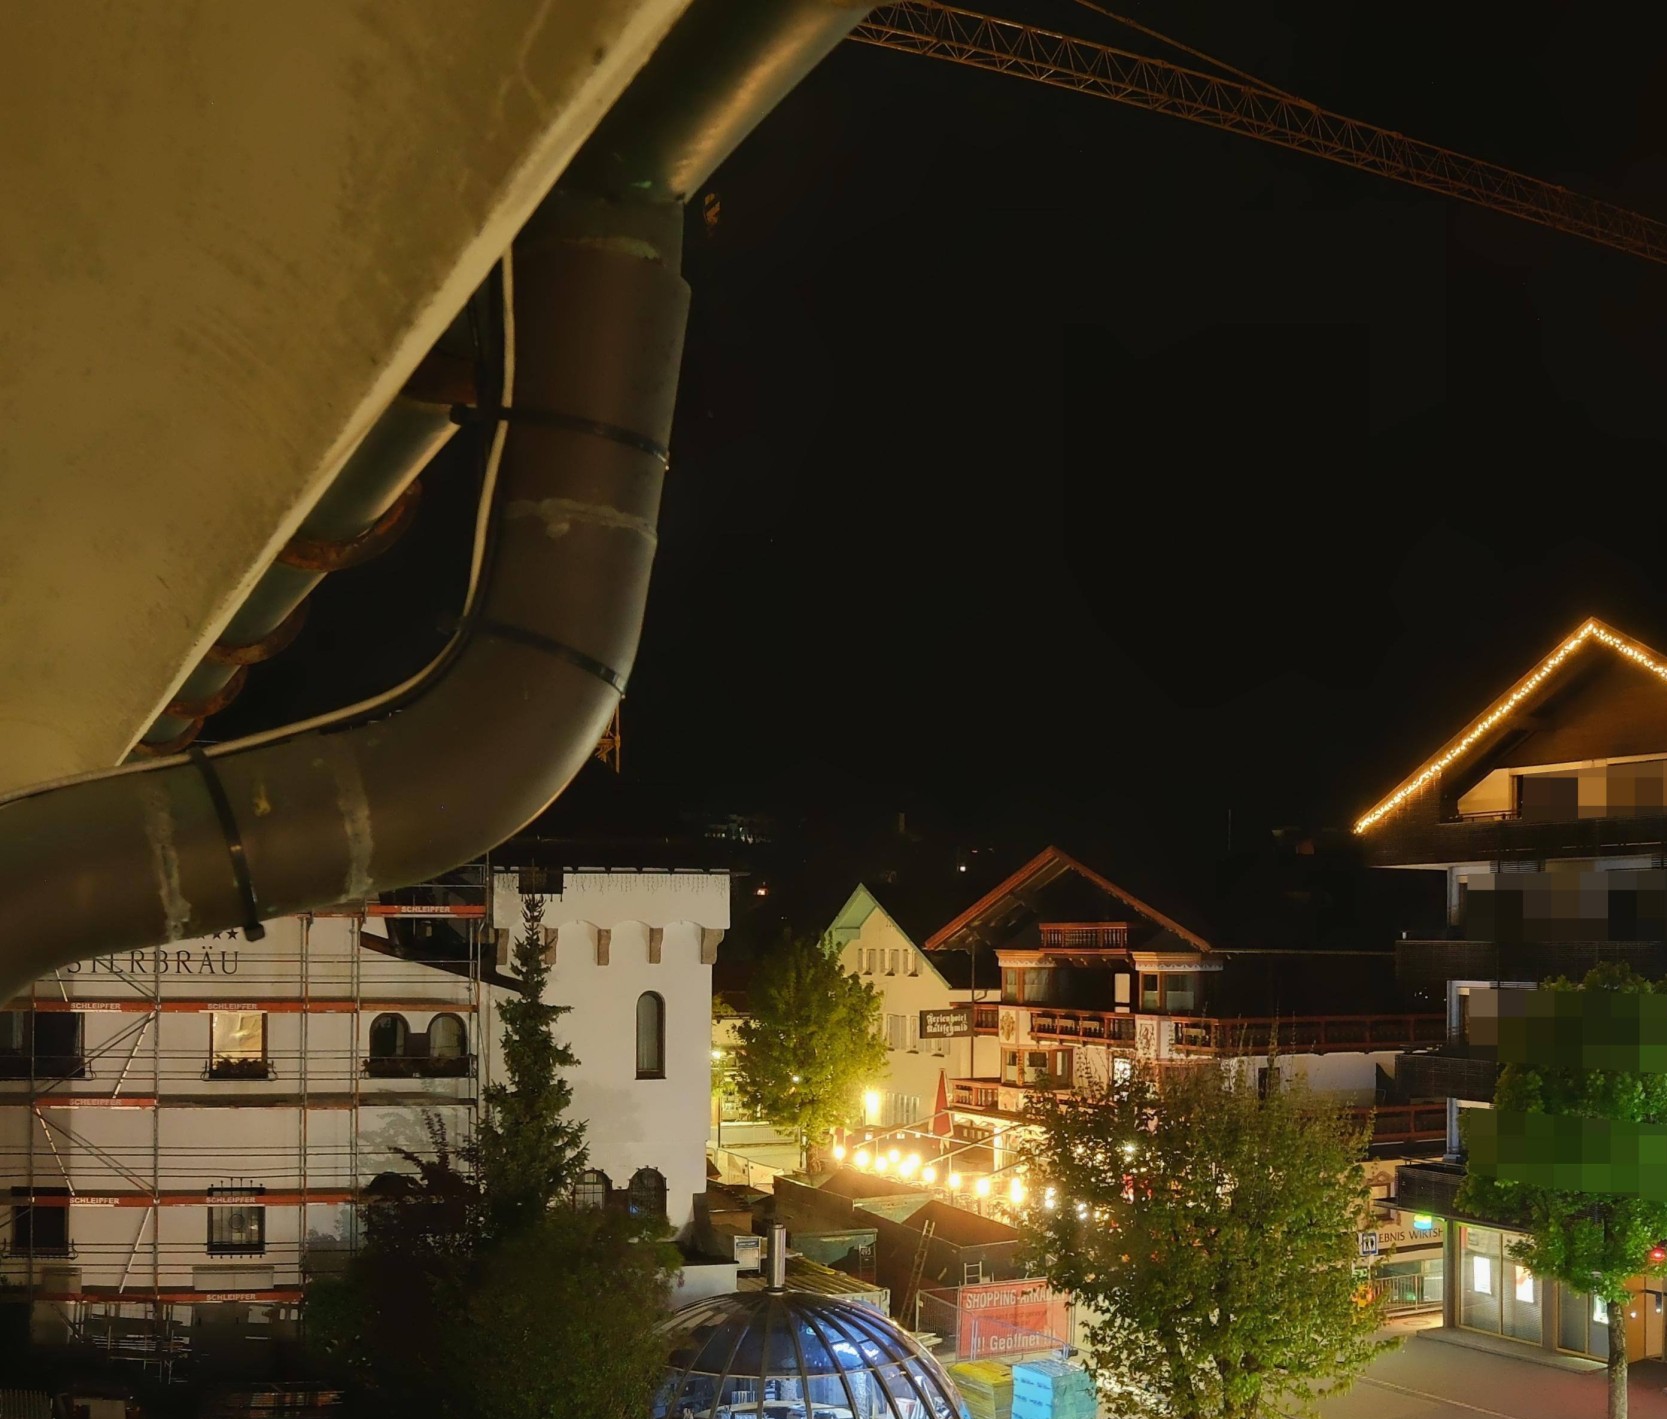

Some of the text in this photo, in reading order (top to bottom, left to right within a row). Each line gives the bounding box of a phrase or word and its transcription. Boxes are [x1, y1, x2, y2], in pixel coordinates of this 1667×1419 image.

[70, 1098, 122, 1106] SCHLEIPFER
[69, 1197, 121, 1205] SCHLEIPFER
[206, 1196, 257, 1204] SCHLEIPFER
